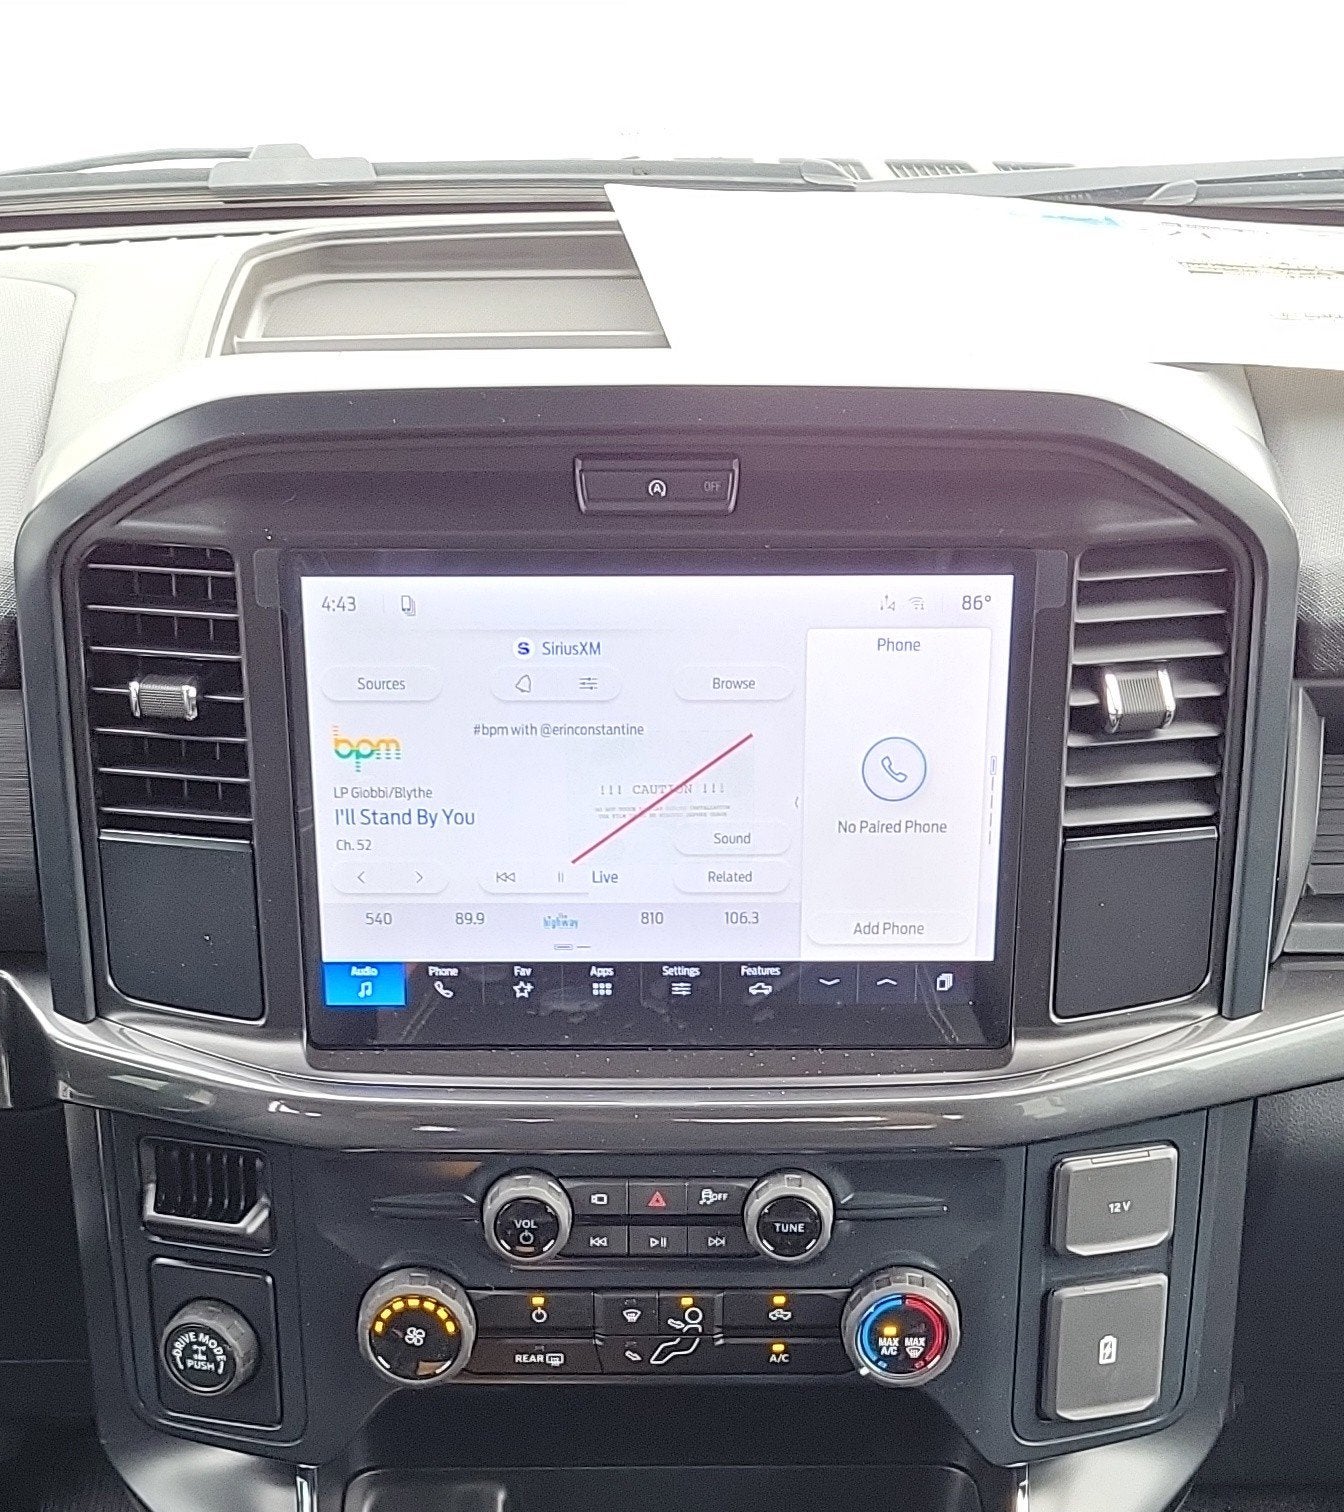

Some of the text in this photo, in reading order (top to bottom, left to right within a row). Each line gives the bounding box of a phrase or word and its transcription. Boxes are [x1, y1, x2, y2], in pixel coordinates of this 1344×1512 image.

[321, 595, 357, 612] 4:43
[961, 594, 992, 611] 86°
[541, 641, 602, 656] SiriusXM
[876, 637, 921, 652] Phone
[357, 676, 406, 691] Sources
[712, 677, 756, 690] Browse
[473, 722, 645, 738] #bpm with @erinconstantine
[332, 724, 402, 774] bpm
[333, 786, 433, 802] LP Giobbi/Blythe
[334, 808, 476, 829] I'll Stand By You
[838, 820, 948, 834] No Paired Phone
[336, 839, 372, 851] Ch. 52
[713, 832, 752, 845] Sound
[591, 870, 619, 884] Live
[707, 870, 753, 883] Related
[365, 912, 393, 926] 540
[455, 912, 485, 926] 89.9
[640, 911, 664, 925] 810
[724, 911, 759, 925] 106.3
[853, 921, 925, 935] Add Phone
[350, 965, 379, 977] Audio
[428, 965, 459, 977] Phone
[513, 965, 532, 977] Fav
[589, 965, 615, 978] Apps
[662, 965, 701, 978] Settings
[740, 965, 781, 976] Features
[712, 1191, 729, 1202] OFF
[514, 1218, 539, 1230] VOL
[774, 1222, 806, 1234] TUNE
[171, 1331, 227, 1362] DRIVE MODE
[877, 1337, 900, 1348] MAX
[904, 1337, 926, 1348] MAX
[515, 1352, 545, 1364] REAR
[880, 1346, 899, 1357] A/C
[185, 1358, 216, 1371] PUSH
[769, 1353, 790, 1364] A/C
